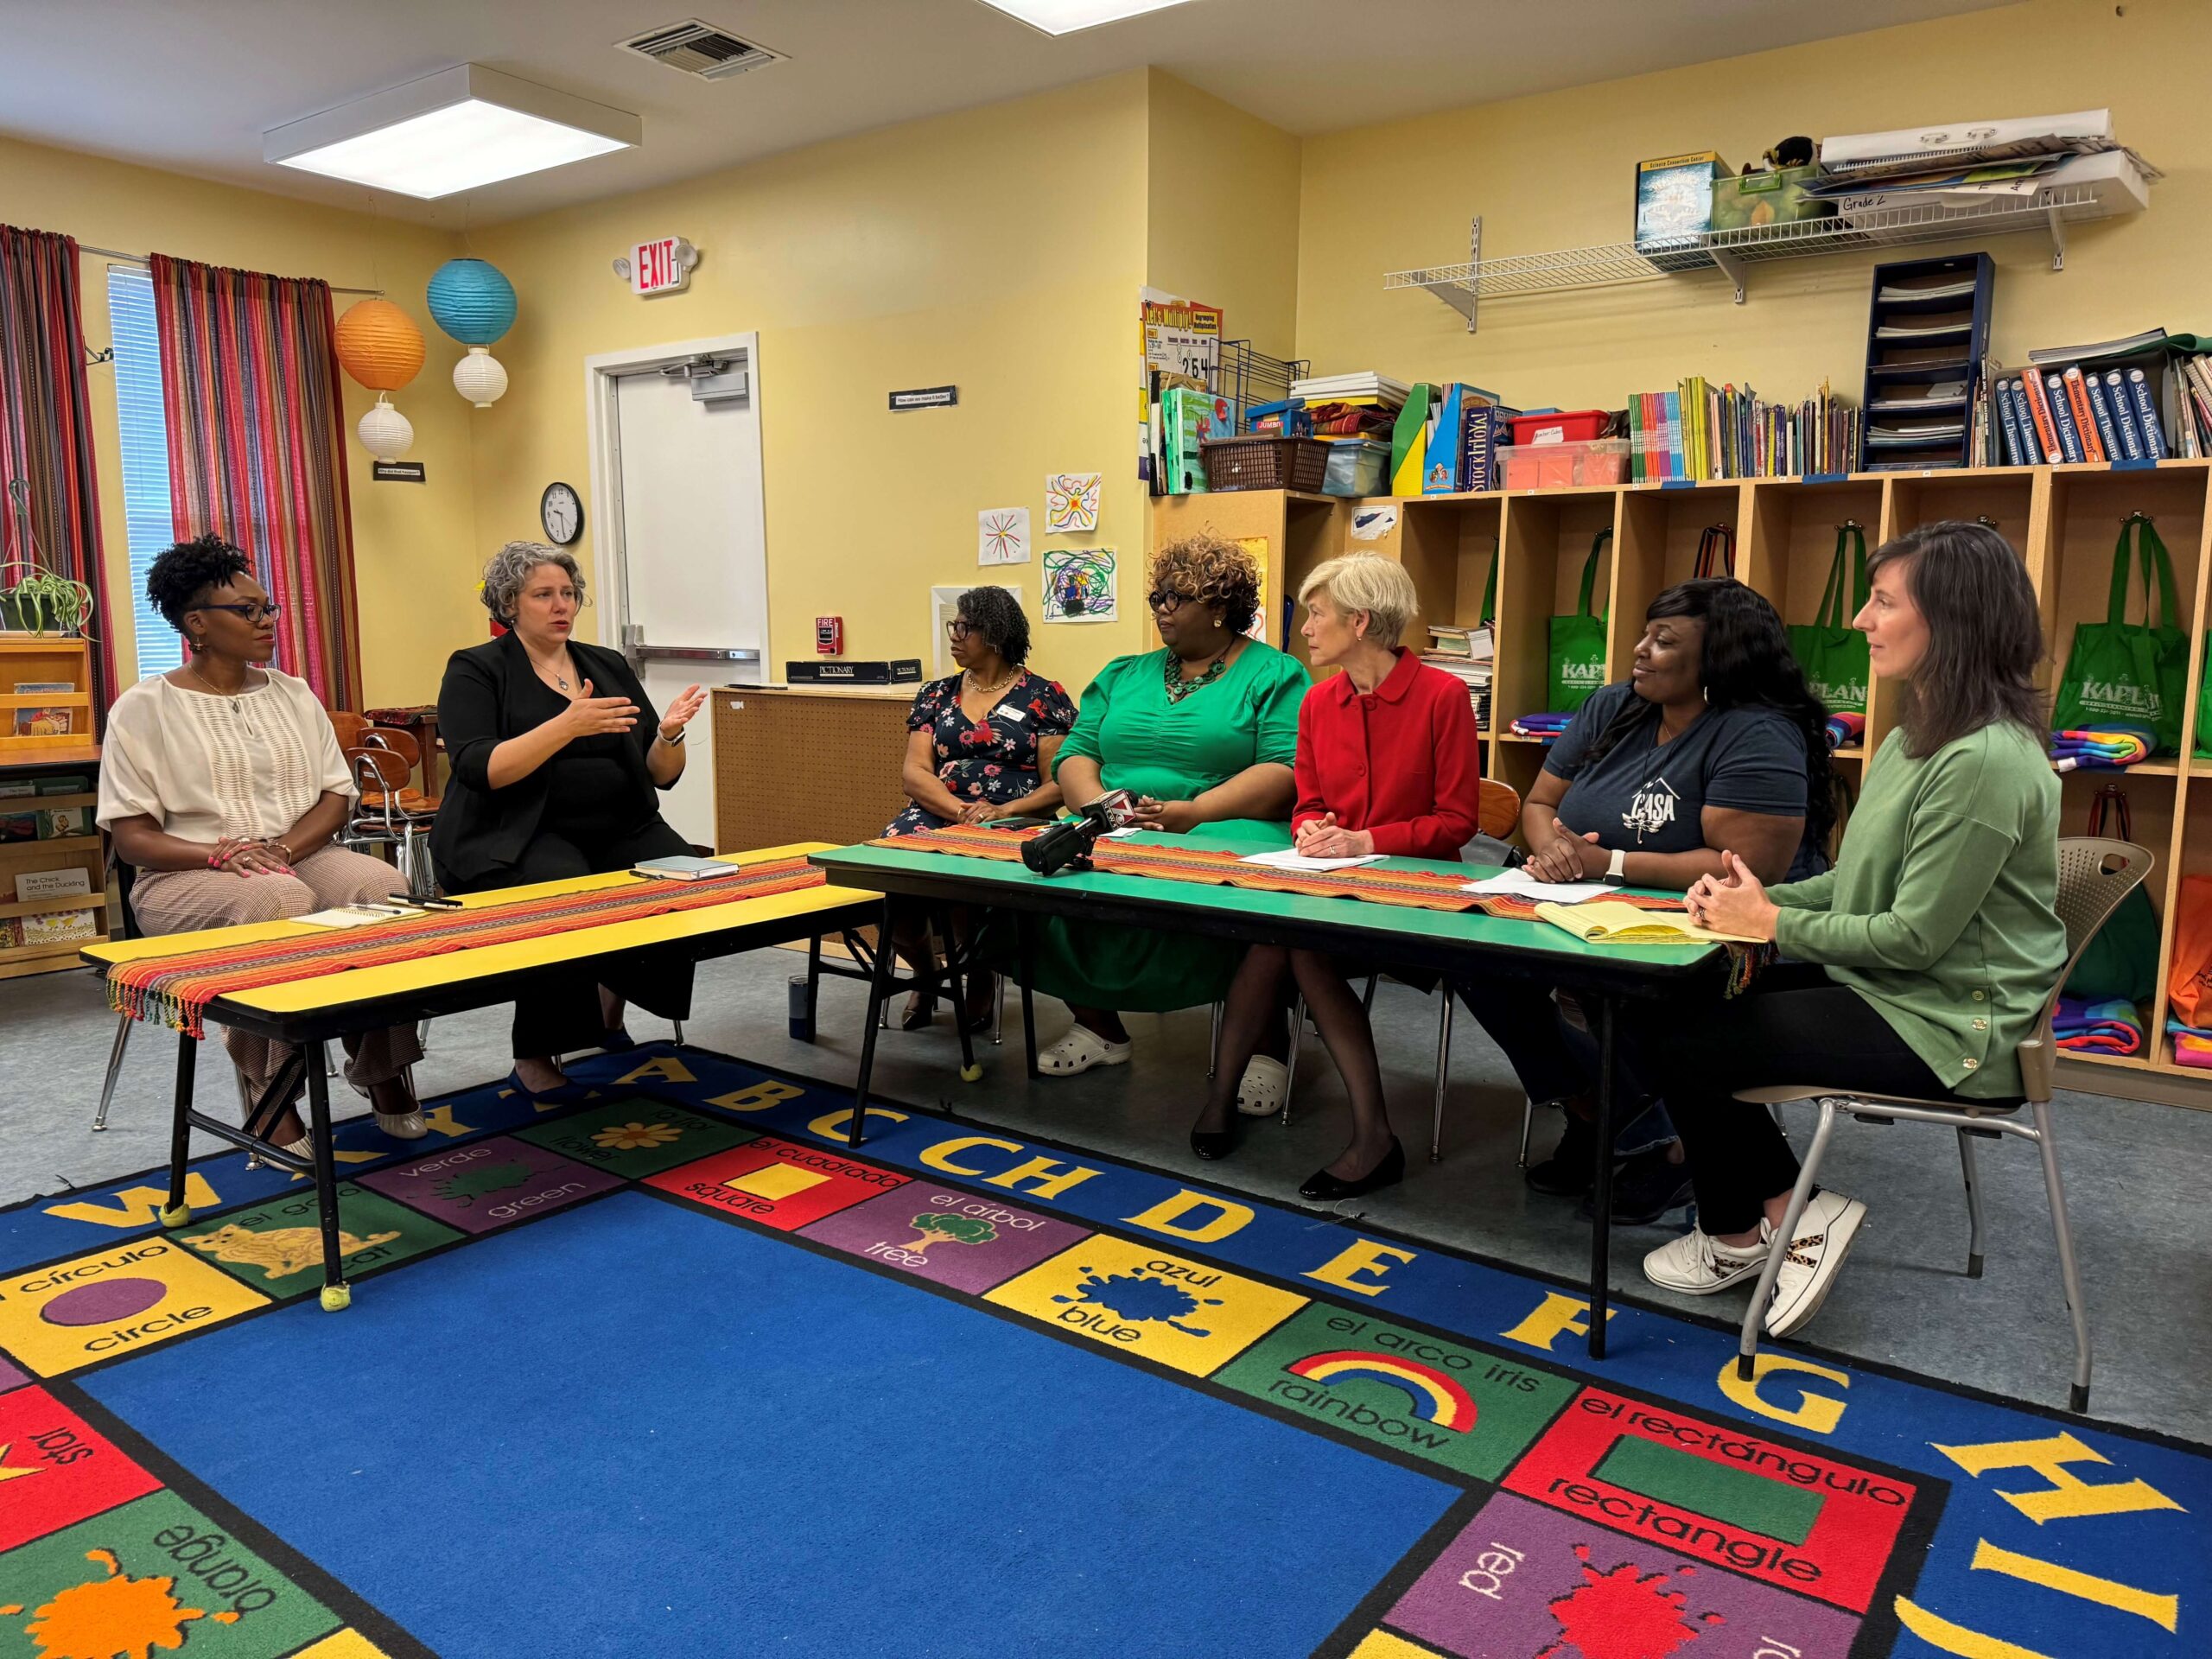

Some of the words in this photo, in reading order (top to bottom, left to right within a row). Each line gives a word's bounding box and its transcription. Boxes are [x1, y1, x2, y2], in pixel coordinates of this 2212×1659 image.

[1842, 194, 1874, 211] Grade
[1876, 195, 1886, 206] 2
[638, 239, 673, 289] EXIT
[1146, 306, 1161, 327] Let's
[1162, 308, 1192, 332] Multiply!
[2000, 392, 2014, 421] School
[2016, 392, 2031, 420] School
[2053, 389, 2069, 417] School
[2070, 379, 2085, 416] Elementary
[2081, 416, 2095, 454] Dictionary
[2113, 386, 2130, 416] School
[2135, 383, 2152, 413] School
[2005, 421, 2019, 465] Thesaurus
[2022, 420, 2038, 465] Thesaurus
[2041, 415, 2056, 452] Elementary
[2060, 417, 2078, 463] Dictionary
[2091, 388, 2108, 417] School
[2101, 417, 2120, 461] Thesaurus
[2120, 416, 2139, 461] Dictionary
[2143, 413, 2160, 460] Dictionary
[817, 618, 834, 627] FIRE
[819, 665, 855, 674] PICTIONARY
[1103, 803, 1118, 828] NEWS
[1630, 792, 1675, 822] CASA
[398, 1147, 492, 1179] verde
[549, 1135, 620, 1162] flower
[748, 1137, 772, 1154] el
[775, 1144, 901, 1189] cuadrado
[42, 1173, 222, 1227] W
[239, 1212, 273, 1227] el
[282, 1187, 361, 1216] go
[487, 1178, 587, 1220] green
[683, 1180, 776, 1217] square
[930, 1192, 957, 1208] el
[959, 1200, 1047, 1232] árbol
[607, 1057, 699, 1084] A
[702, 1079, 805, 1112] B
[807, 1108, 910, 1143] C
[918, 1136, 1106, 1201] CH
[1119, 1188, 1255, 1243] D
[1299, 1238, 1419, 1297] E
[1498, 1291, 1618, 1351] F
[1716, 1352, 1849, 1434] G
[863, 1239, 929, 1269] tree
[20, 1243, 170, 1294] círculo
[1146, 1257, 1224, 1288] azul
[84, 1303, 215, 1353] circle
[1057, 1305, 1142, 1344] blue
[1326, 1313, 1357, 1337] el
[1374, 1332, 1472, 1371] arco
[1484, 1363, 1541, 1395] iris
[1267, 1378, 1451, 1450] rainbow
[27, 1426, 93, 1465] star
[1580, 1395, 1624, 1420] el
[1627, 1411, 1907, 1507] rectángulo
[1929, 1431, 2190, 1526] H
[1547, 1475, 1823, 1583] rectangle
[153, 1524, 277, 1613] orange
[1458, 1541, 1526, 1601] red
